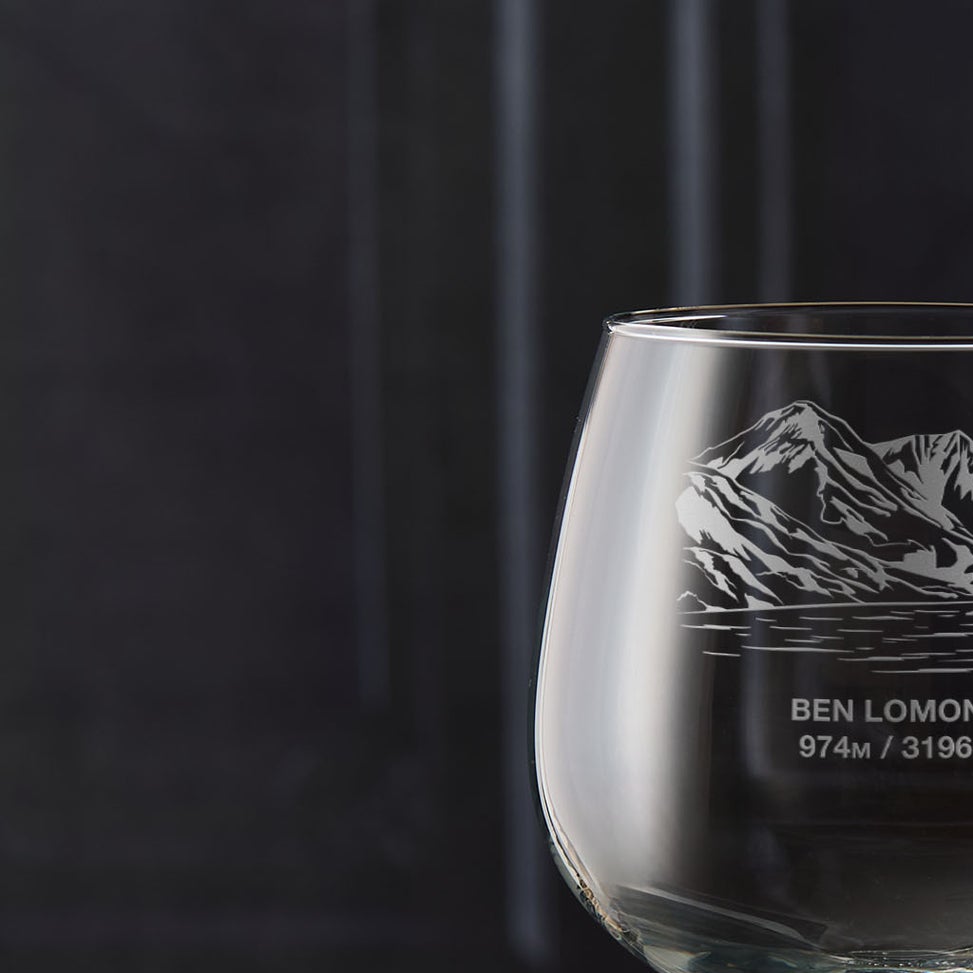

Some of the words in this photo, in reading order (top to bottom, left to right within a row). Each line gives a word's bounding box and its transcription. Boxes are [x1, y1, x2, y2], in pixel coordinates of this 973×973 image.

[791, 698, 854, 722] BEN
[799, 735, 871, 759] 974M
[880, 735, 894, 759] /
